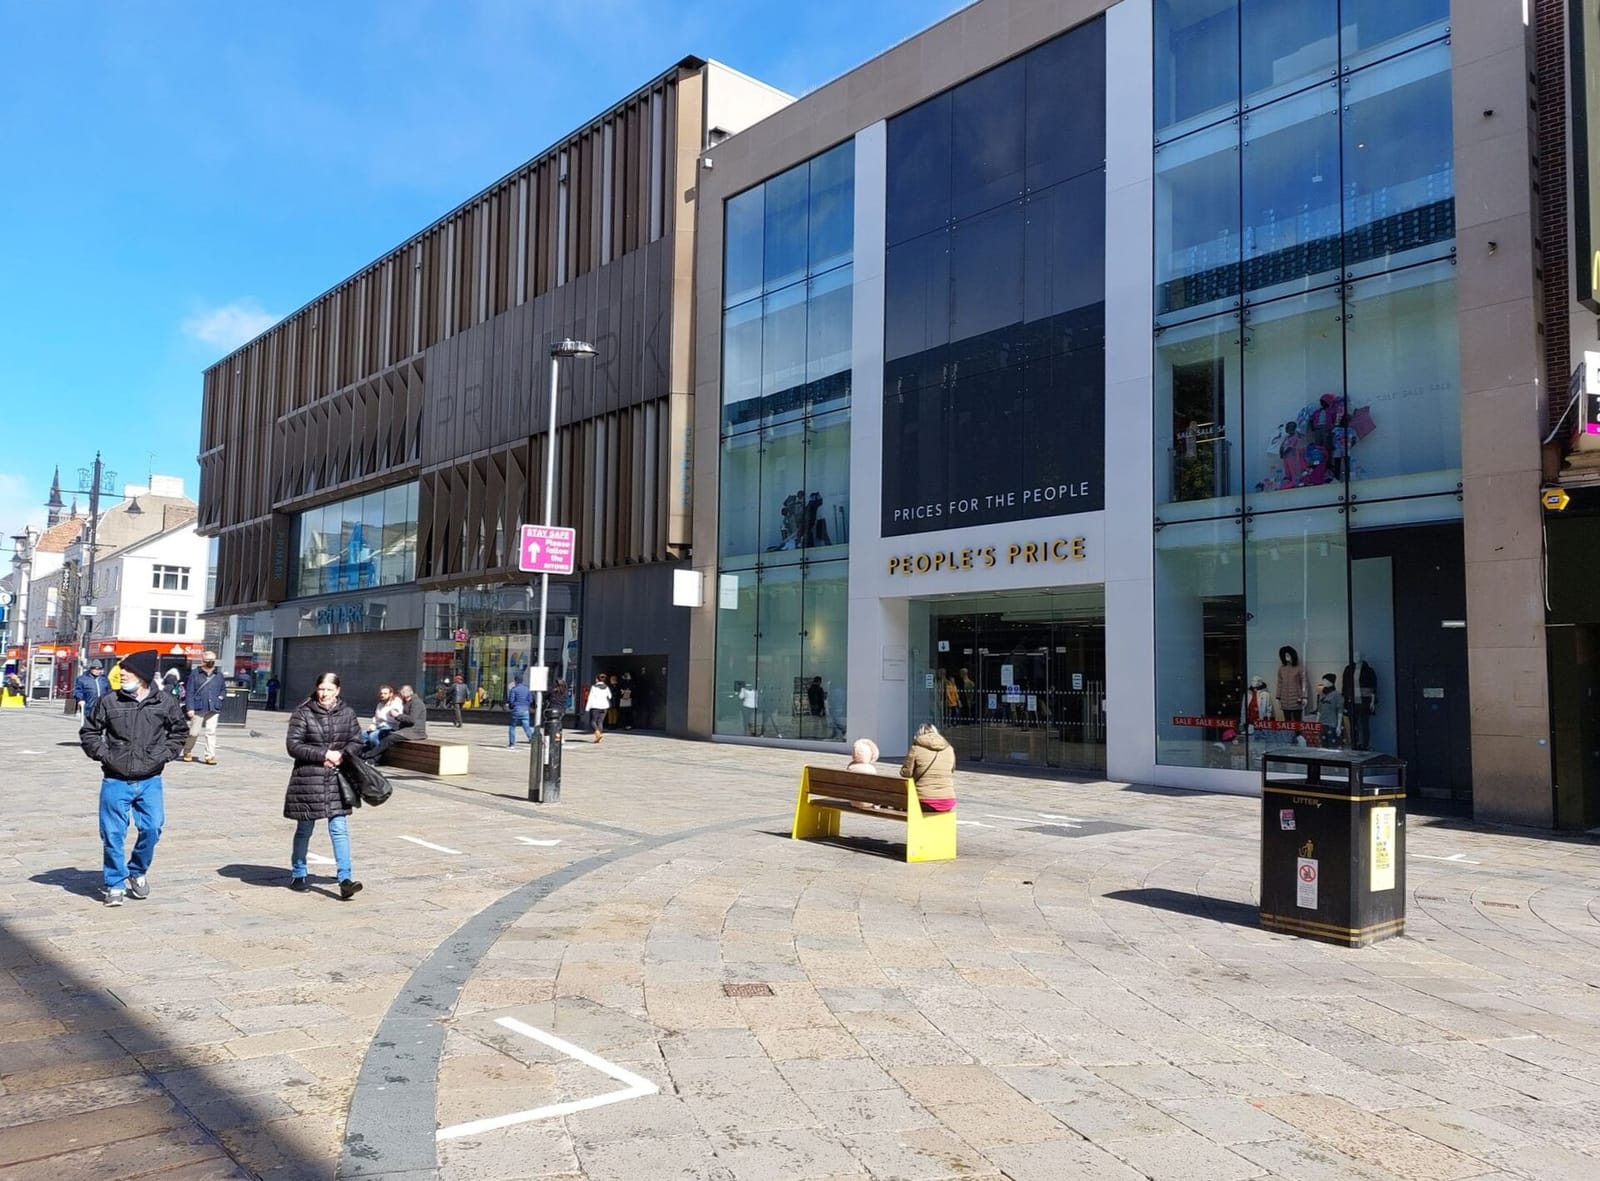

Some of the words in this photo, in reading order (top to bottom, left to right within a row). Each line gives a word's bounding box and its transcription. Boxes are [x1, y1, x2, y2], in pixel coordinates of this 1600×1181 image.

[894, 503, 942, 521] PRICES
[950, 498, 978, 514] FOR
[985, 492, 1016, 508] THE
[1023, 481, 1089, 503] PEOPLE
[527, 529, 547, 538] STAY
[549, 530, 569, 540] SAFE
[888, 546, 996, 576] PEOPLE'S
[1008, 536, 1086, 565] PRICE
[314, 603, 363, 626] PRIMARK
[1174, 717, 1191, 725] SALE
[1195, 718, 1212, 727] SALE
[1216, 719, 1234, 728] SALE
[1254, 720, 1273, 729] SALE
[1276, 721, 1296, 730] SALE
[1300, 722, 1321, 731] SALE
